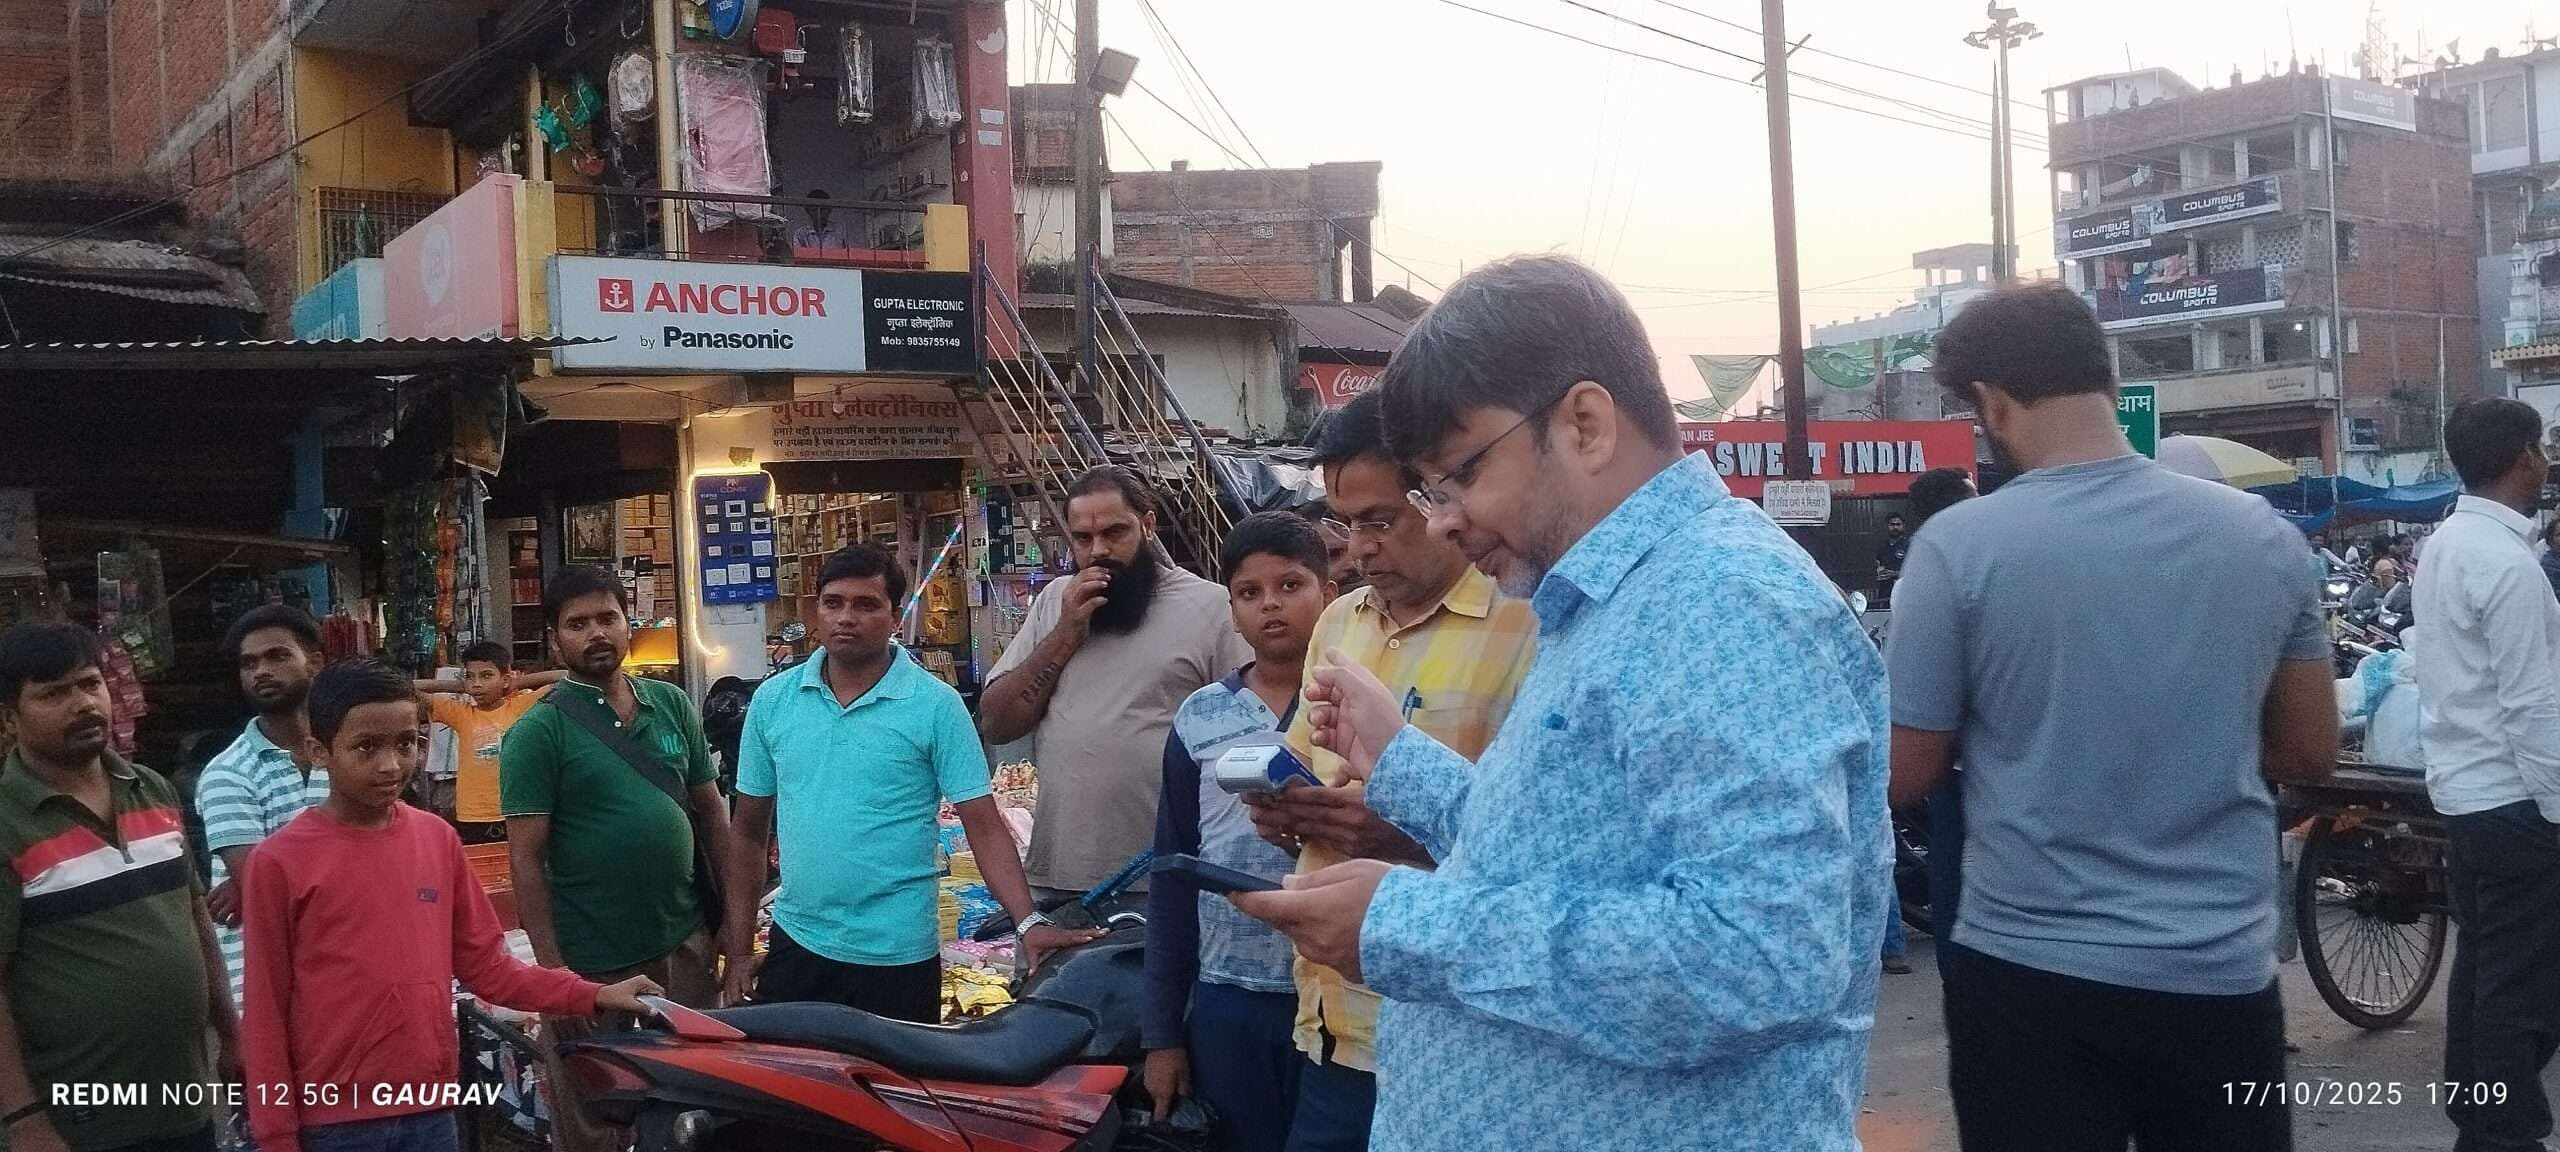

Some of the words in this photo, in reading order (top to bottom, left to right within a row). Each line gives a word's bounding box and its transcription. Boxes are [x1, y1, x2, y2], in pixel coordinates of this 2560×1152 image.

[2183, 192, 2245, 211] COLUMBUS
[2072, 220, 2130, 238] COLUMBUS
[644, 282, 828, 318] ANCHOR
[2141, 284, 2218, 304] COLUMBUS
[873, 298, 905, 309] GUPTA
[907, 299, 965, 311] ELECTRONIC
[886, 317, 908, 331] गुप्ता
[640, 335, 656, 350] by
[663, 326, 794, 350] Panasonic
[881, 336, 905, 345] Mob:
[772, 400, 825, 425] गुप्ता
[1681, 430, 1695, 441] AN
[1697, 430, 1714, 441] JEE
[1715, 441, 1826, 477] SWET
[1843, 440, 1927, 475] INDIA
